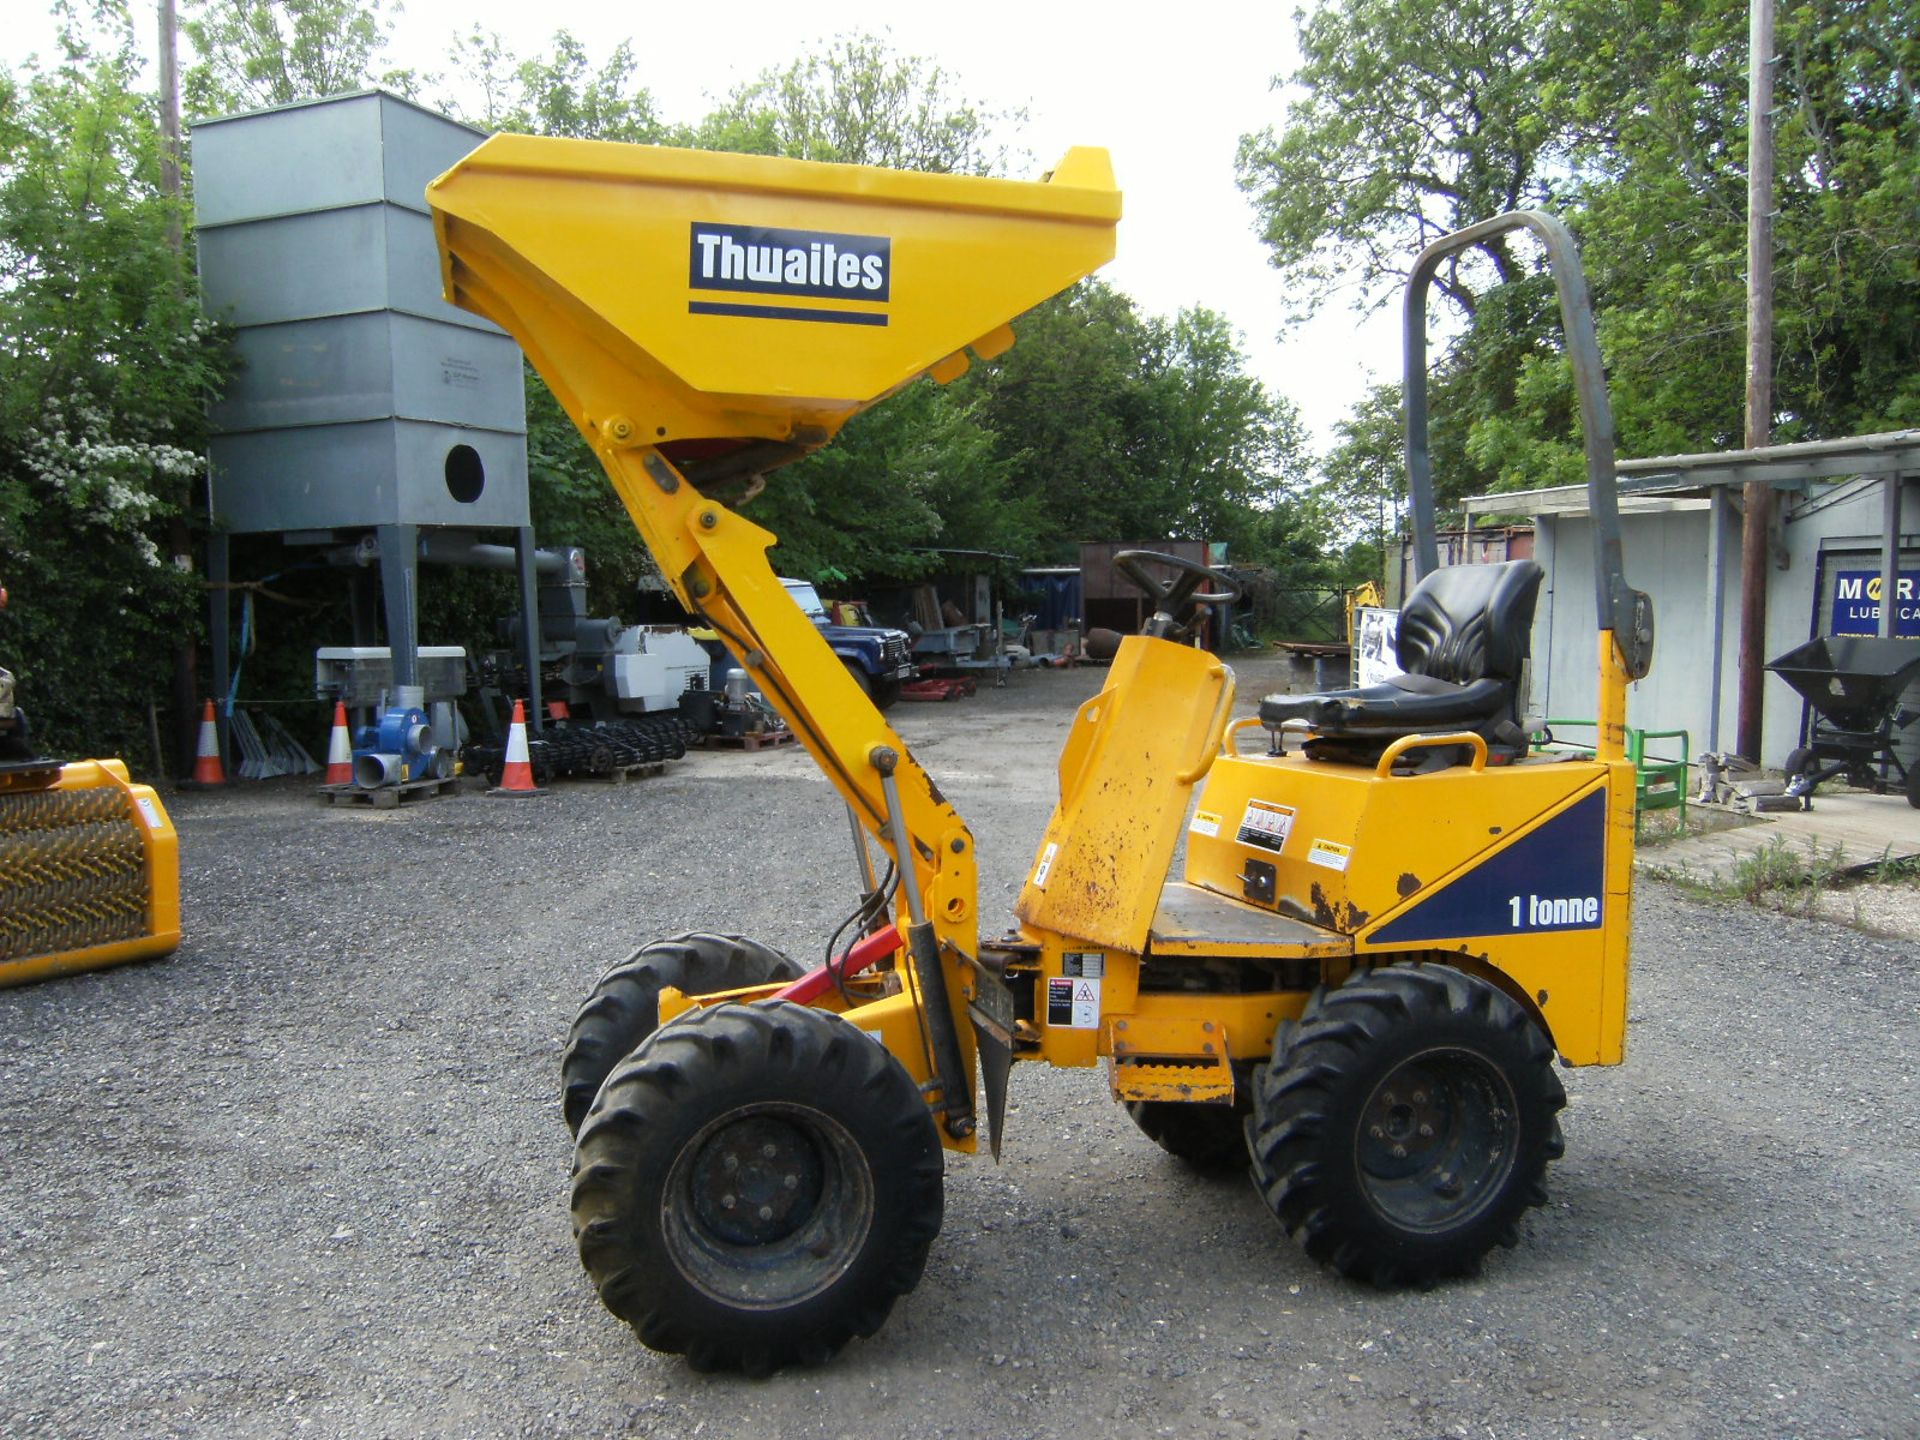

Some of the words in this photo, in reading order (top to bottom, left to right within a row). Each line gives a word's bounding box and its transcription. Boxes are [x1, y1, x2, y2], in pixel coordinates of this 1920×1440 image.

[697, 234, 883, 290] Thwaites
[1838, 577, 1920, 601] MOR
[1508, 895, 1520, 927] 1
[1529, 894, 1599, 926] tonne
